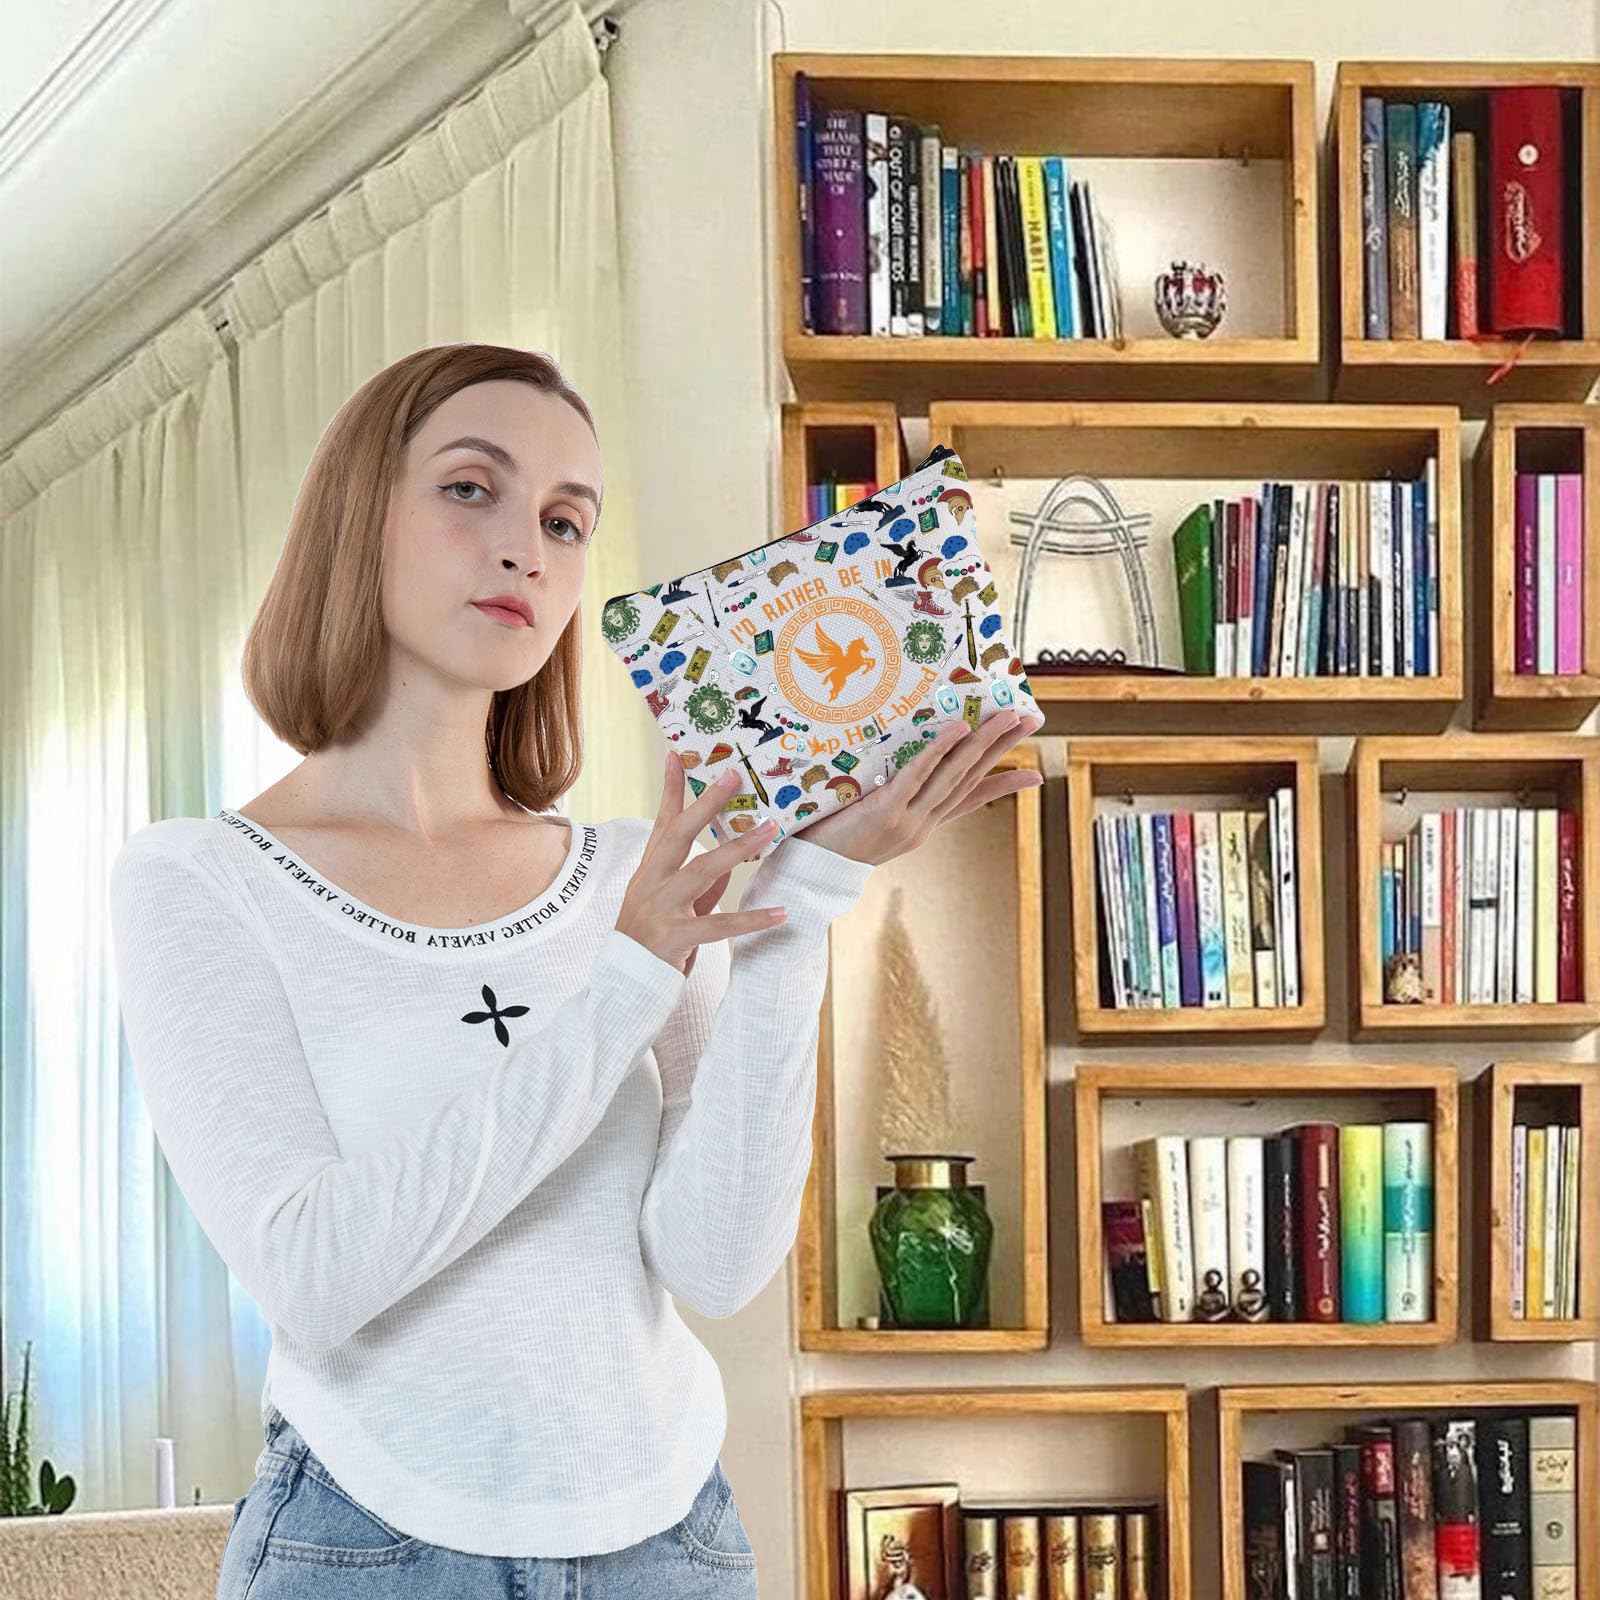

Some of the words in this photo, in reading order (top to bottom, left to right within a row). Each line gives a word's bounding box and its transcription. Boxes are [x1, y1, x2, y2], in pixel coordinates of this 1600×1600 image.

[889, 147, 903, 178] OUT
[890, 179, 904, 201] OF
[891, 203, 905, 235] OUR
[1027, 221, 1046, 273] HABIT
[730, 617, 757, 644] I'D
[761, 577, 829, 622] RATHER
[837, 565, 862, 588] BE
[874, 559, 894, 579] IN
[780, 732, 841, 757] Cp
